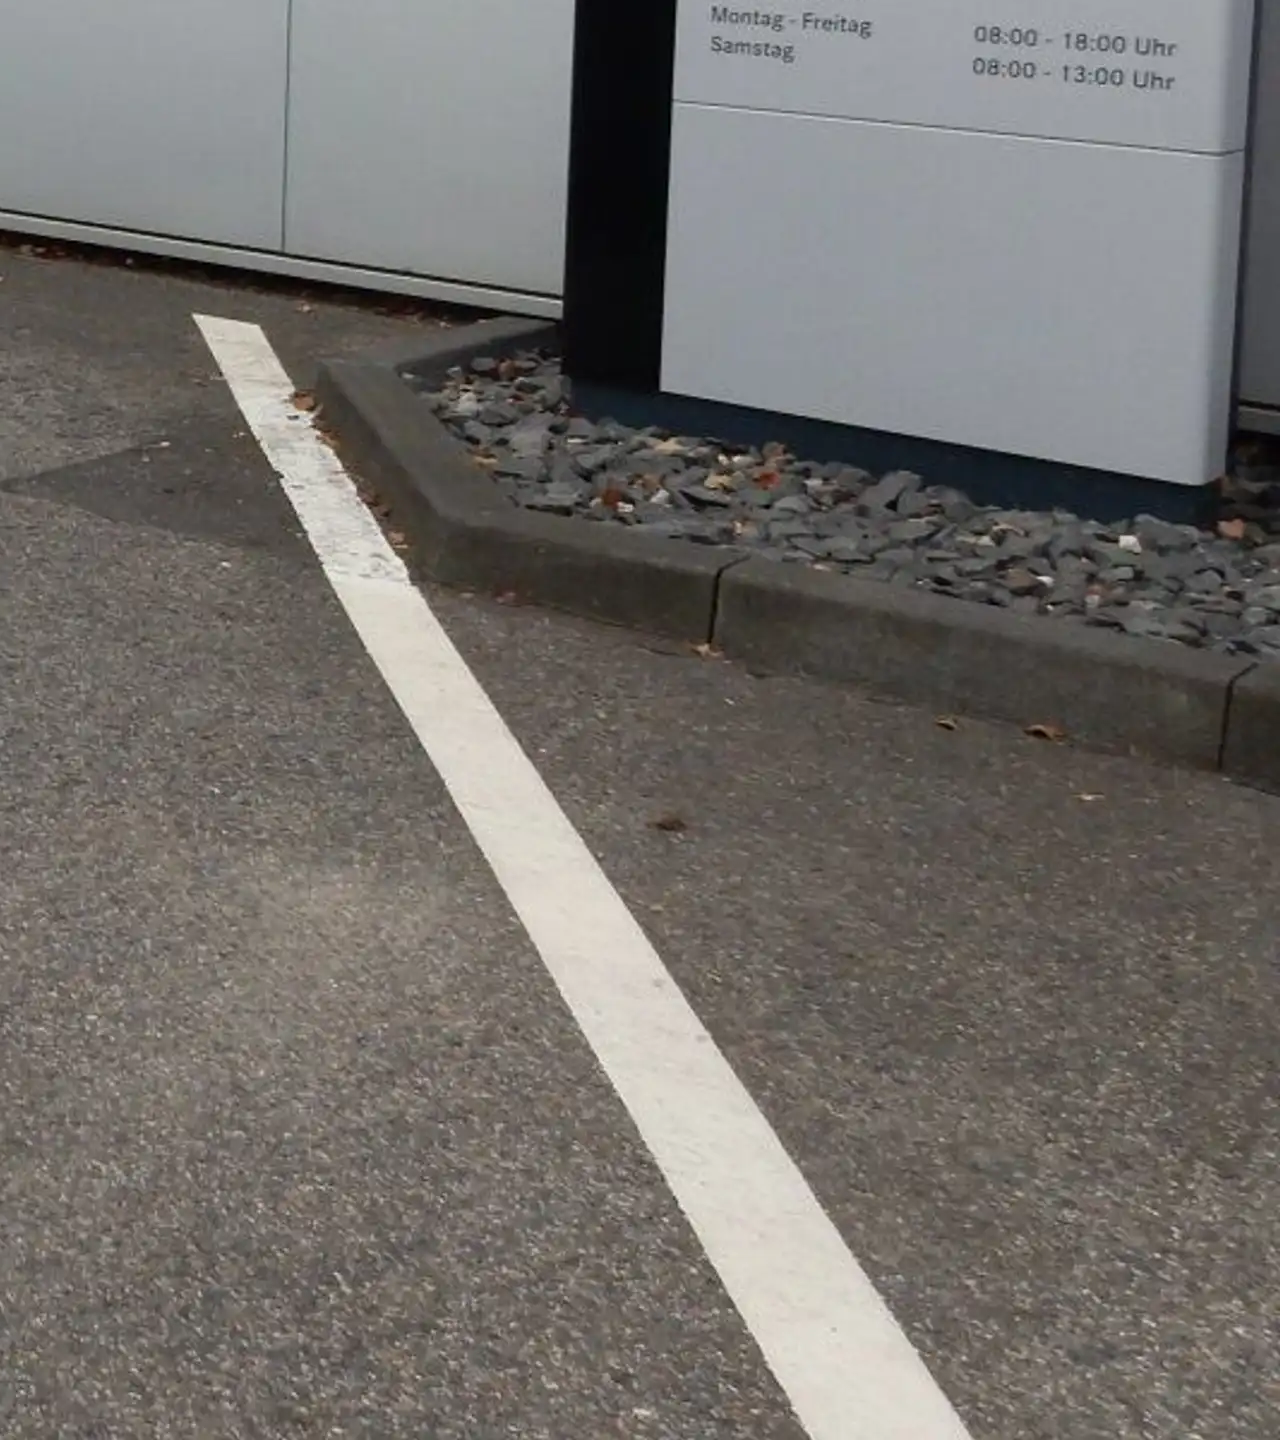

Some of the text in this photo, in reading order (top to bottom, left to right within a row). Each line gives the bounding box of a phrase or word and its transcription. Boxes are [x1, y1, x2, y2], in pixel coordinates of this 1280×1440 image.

[710, 5, 785, 33] Montag
[801, 11, 873, 40] Freitag
[710, 35, 796, 64] Samstag
[973, 25, 1039, 48] 08:00
[1063, 32, 1127, 55] 18:00
[1134, 36, 1178, 57] Uhr
[972, 56, 1038, 80] 08:00
[1062, 64, 1126, 88] 13:00
[1132, 69, 1176, 91] Uhr
